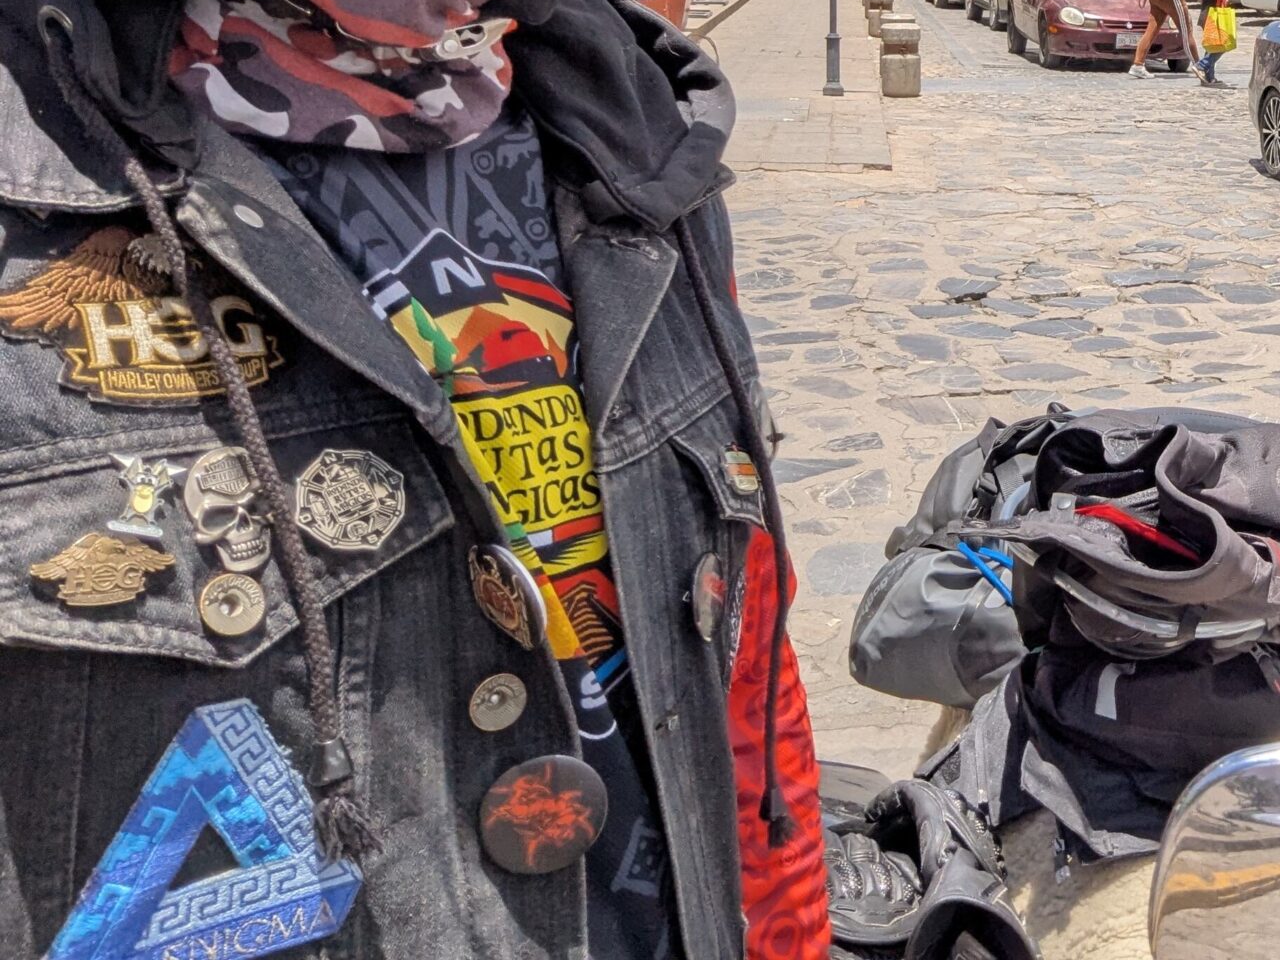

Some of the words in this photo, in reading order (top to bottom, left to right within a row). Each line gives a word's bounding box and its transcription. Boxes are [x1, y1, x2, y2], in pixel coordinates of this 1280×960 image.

[431, 257, 485, 296] N
[108, 370, 161, 391] HARLEY
[163, 370, 219, 391] OWNERS
[324, 453, 338, 465] N
[65, 563, 143, 595] HOG
